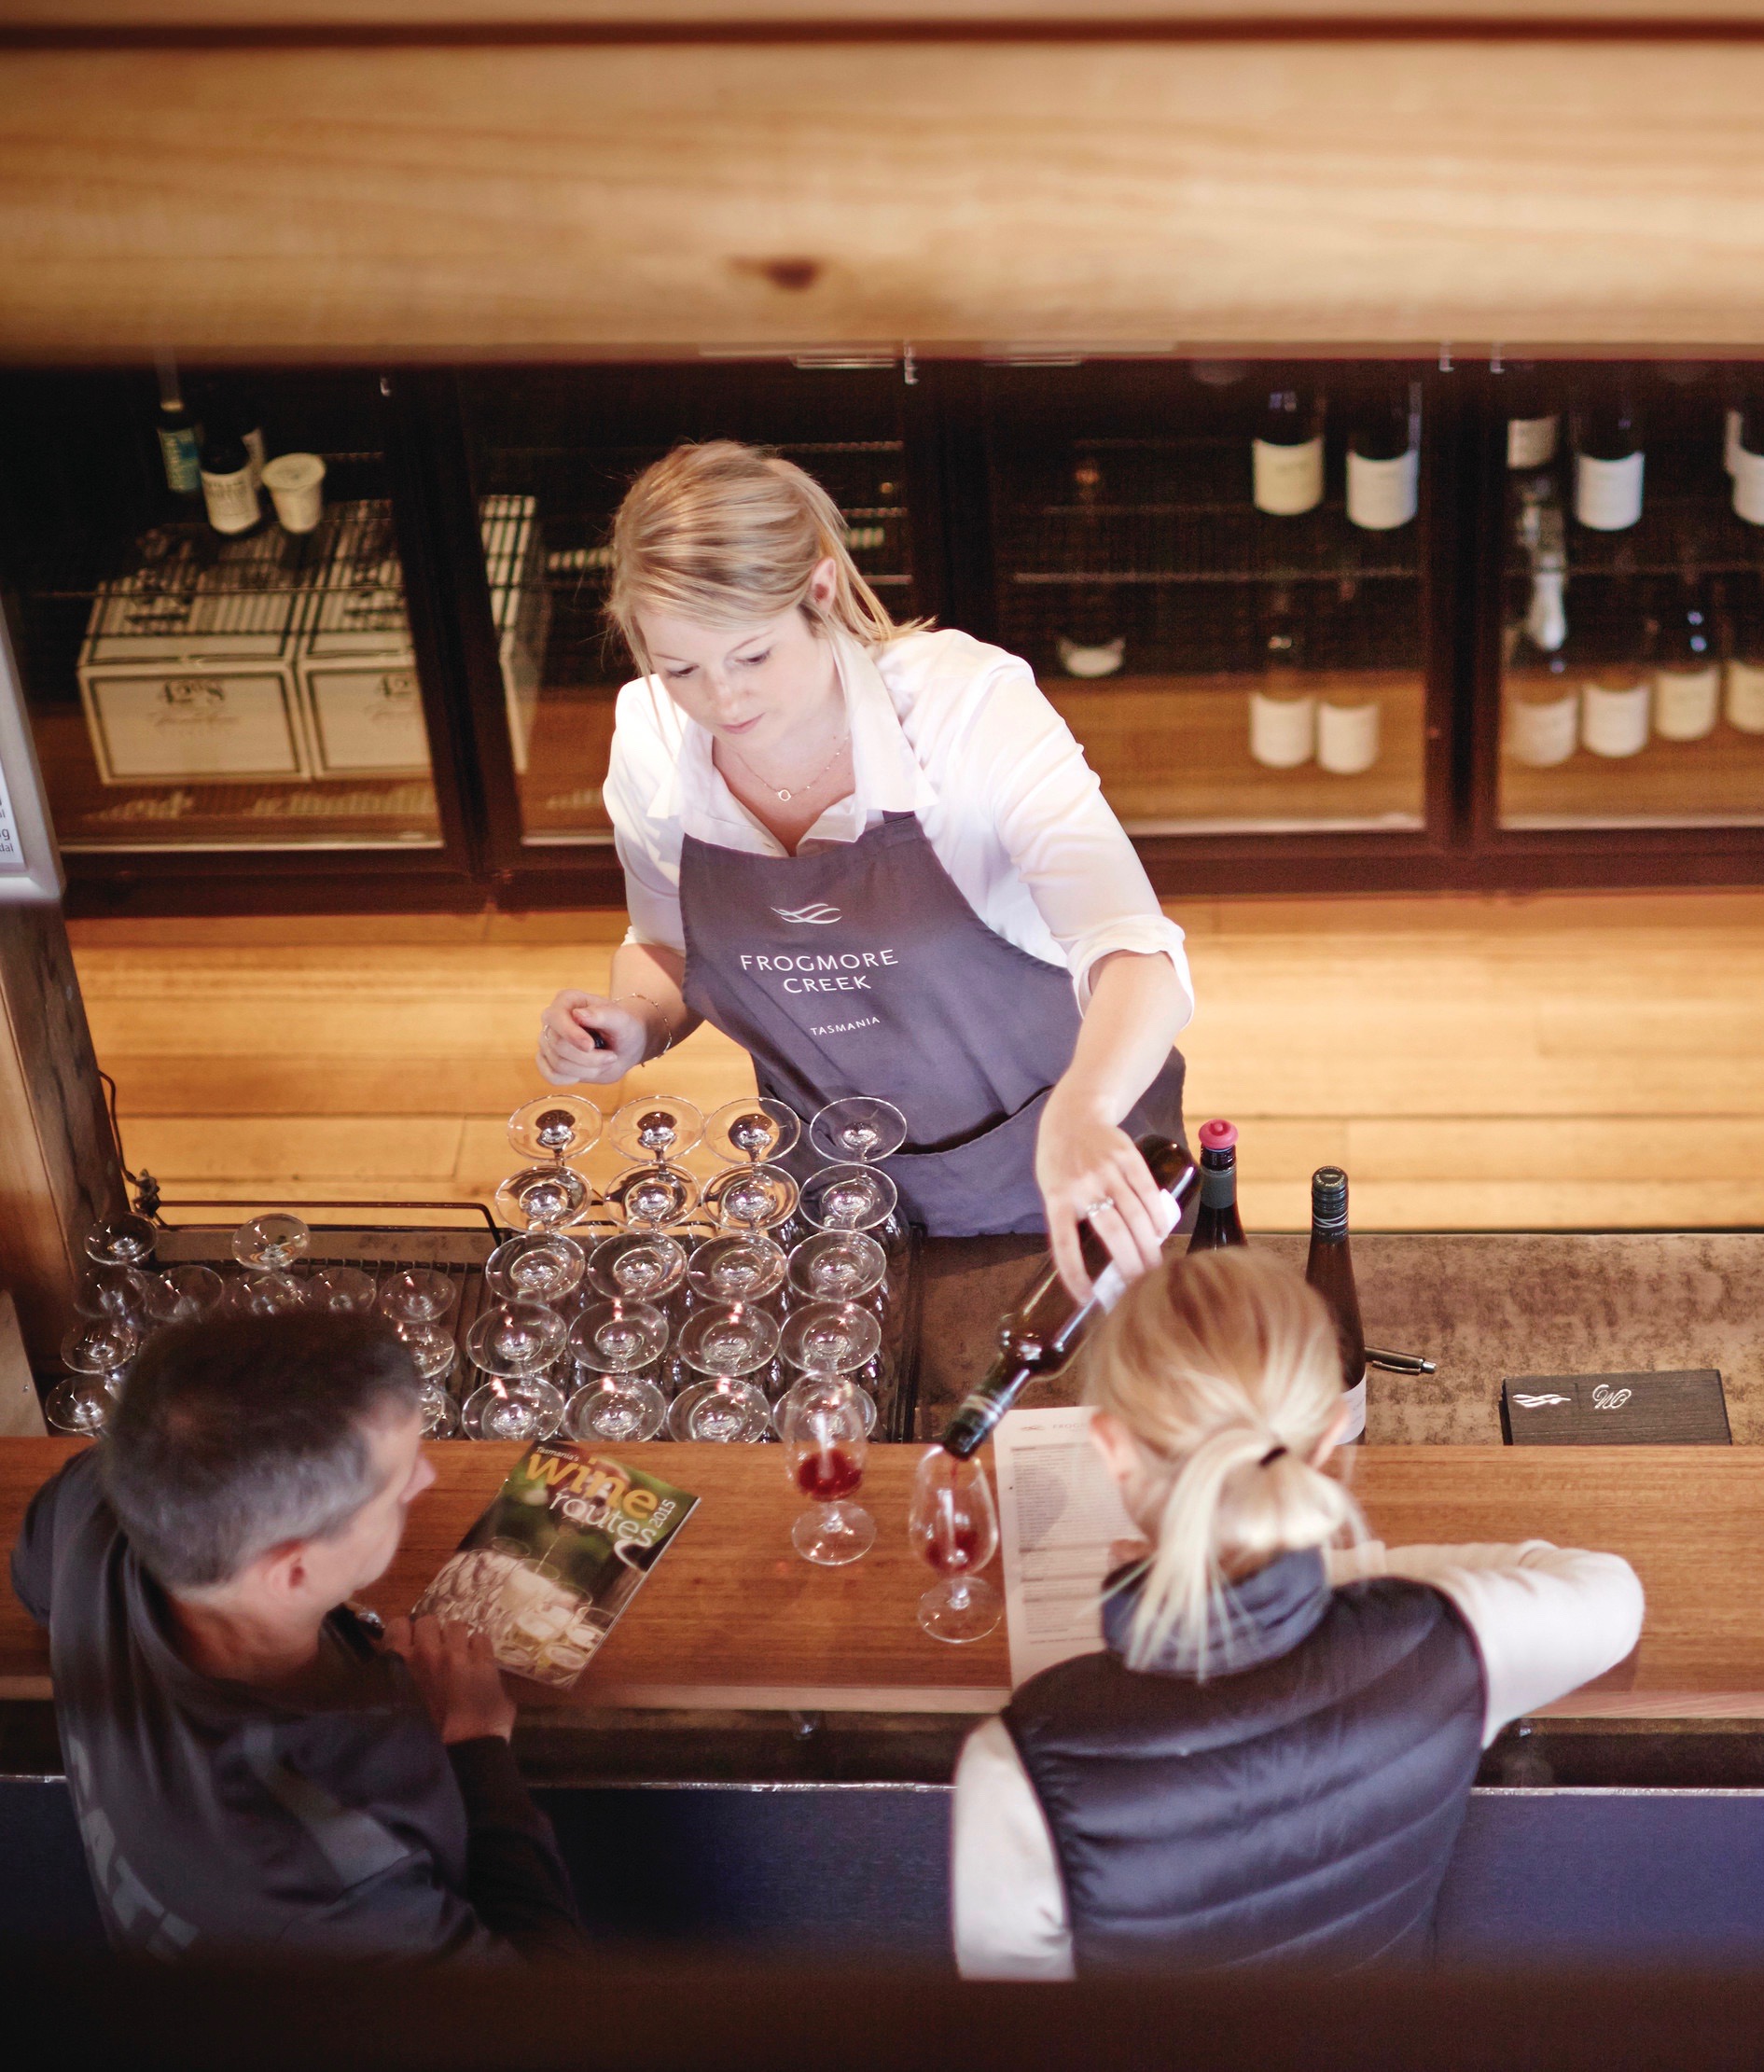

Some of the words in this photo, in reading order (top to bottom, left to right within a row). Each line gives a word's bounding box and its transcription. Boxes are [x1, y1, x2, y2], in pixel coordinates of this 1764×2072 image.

[740, 949, 899, 972] FROGMORE
[783, 975, 871, 994] CREEK
[810, 1016, 881, 1036] TASMANIA
[536, 1446, 580, 1462] Tasmania's
[525, 1453, 659, 1519] wine
[549, 1488, 657, 1552] routes
[649, 1498, 676, 1528] 2015
